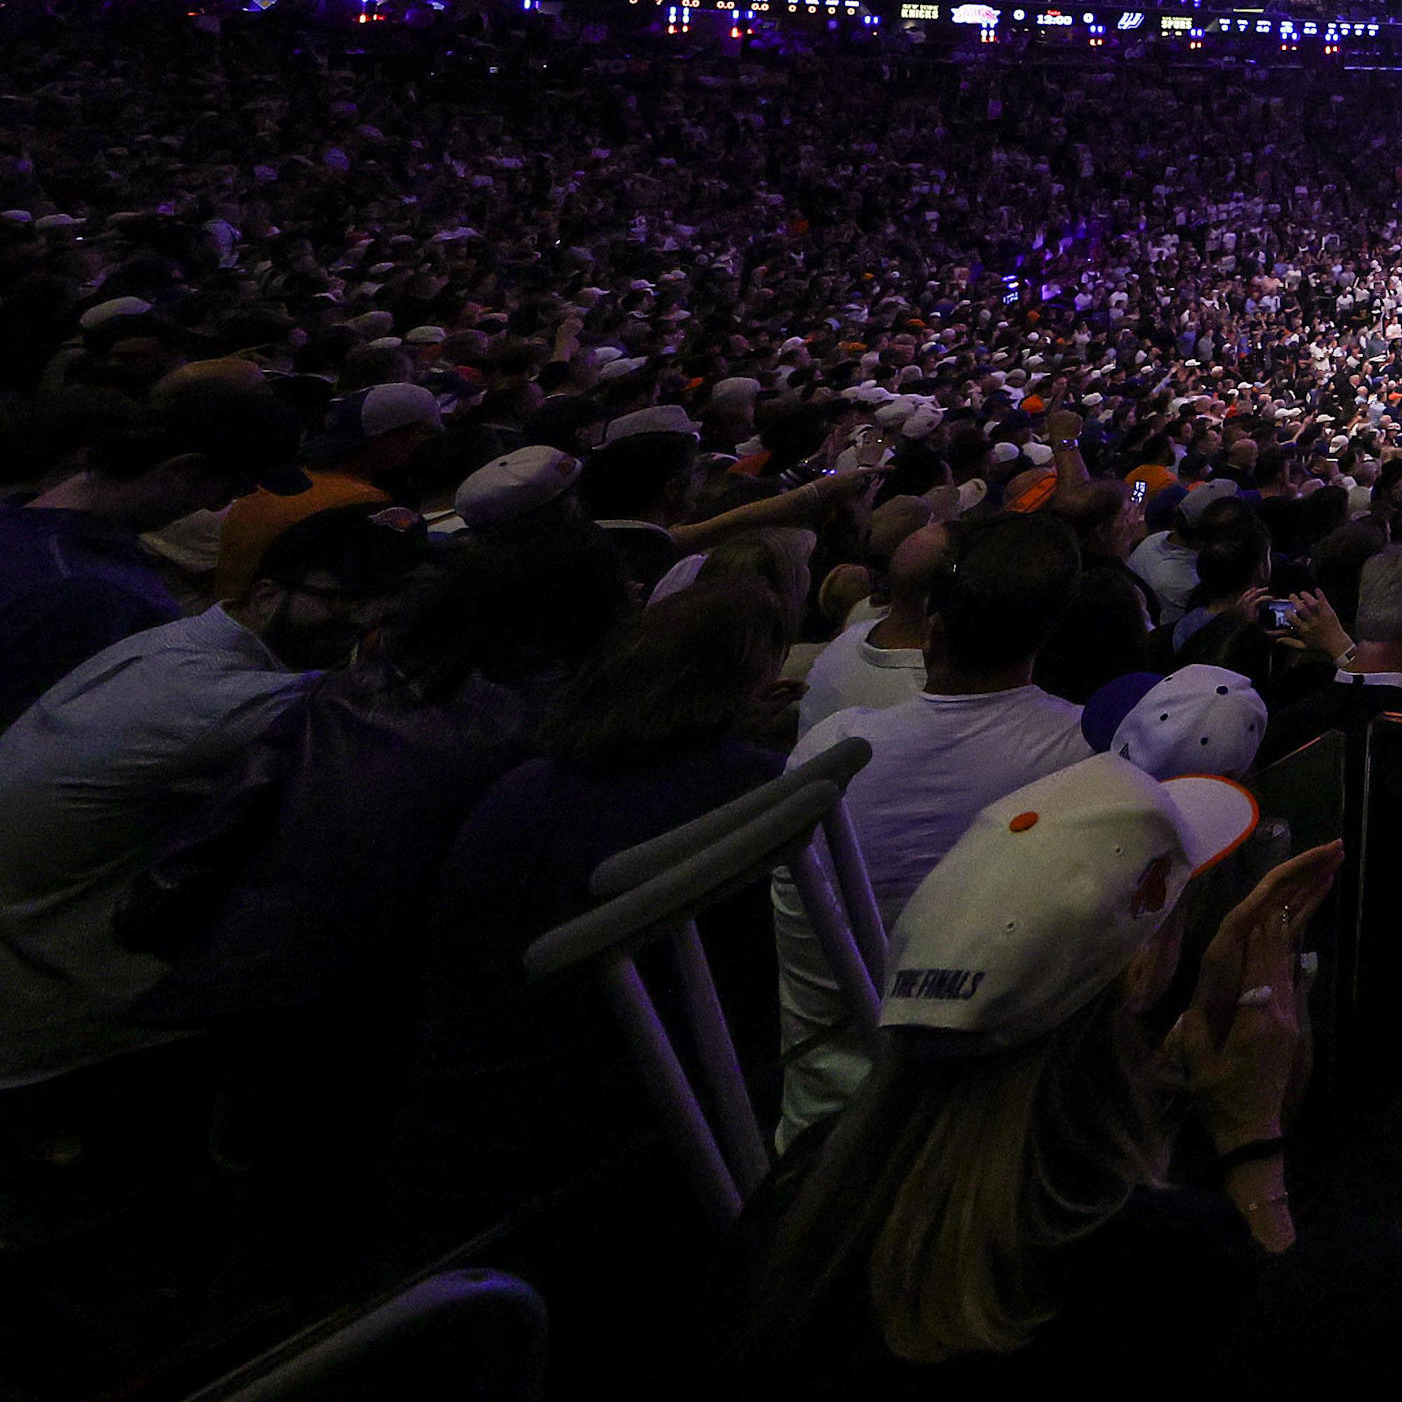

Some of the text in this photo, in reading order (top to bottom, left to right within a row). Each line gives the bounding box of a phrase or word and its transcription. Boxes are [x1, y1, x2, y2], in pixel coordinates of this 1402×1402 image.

[682, 0, 700, 7] 0.0
[717, 1, 735, 9] 0.0
[901, 9, 939, 19] KNICKS
[1037, 14, 1073, 25] 12:00
[1161, 20, 1193, 29] SPURS
[891, 968, 985, 1000] THE FINALS
